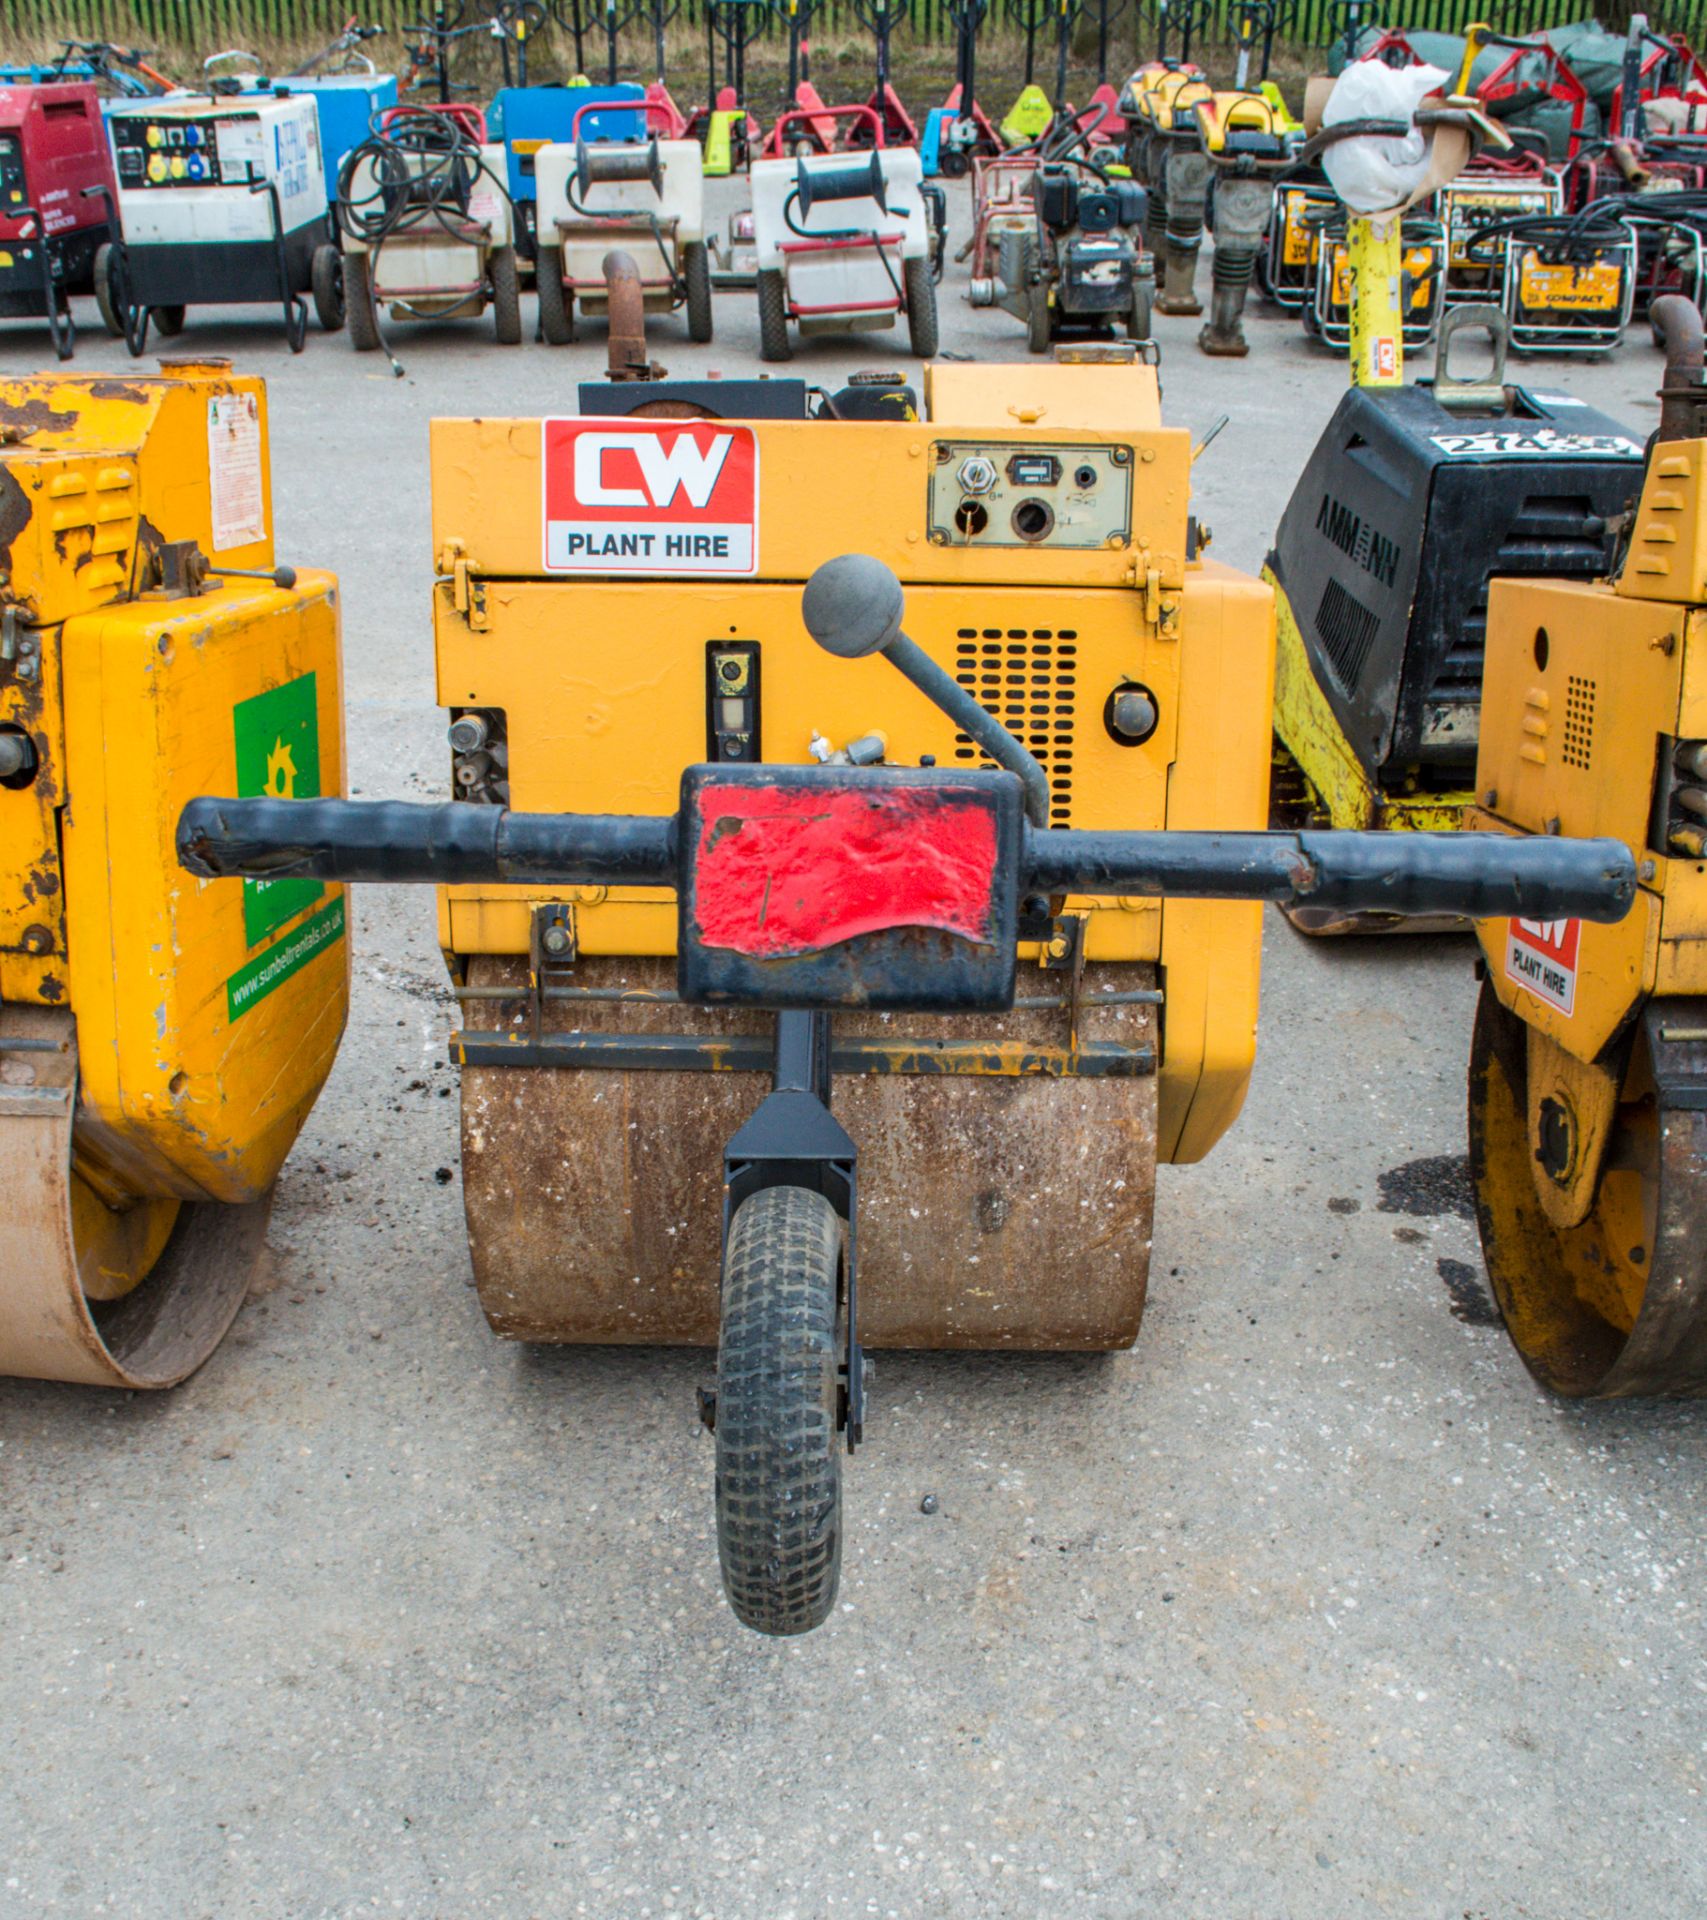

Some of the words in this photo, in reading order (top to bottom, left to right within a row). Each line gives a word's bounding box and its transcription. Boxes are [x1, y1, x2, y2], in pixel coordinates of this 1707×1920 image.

[1546, 294, 1604, 303] COMPACT
[575, 432, 734, 508] CW
[568, 533, 655, 556] PLANT
[666, 535, 729, 557] HIRE
[1513, 948, 1541, 981] PLANT
[1543, 966, 1566, 997] HIRE
